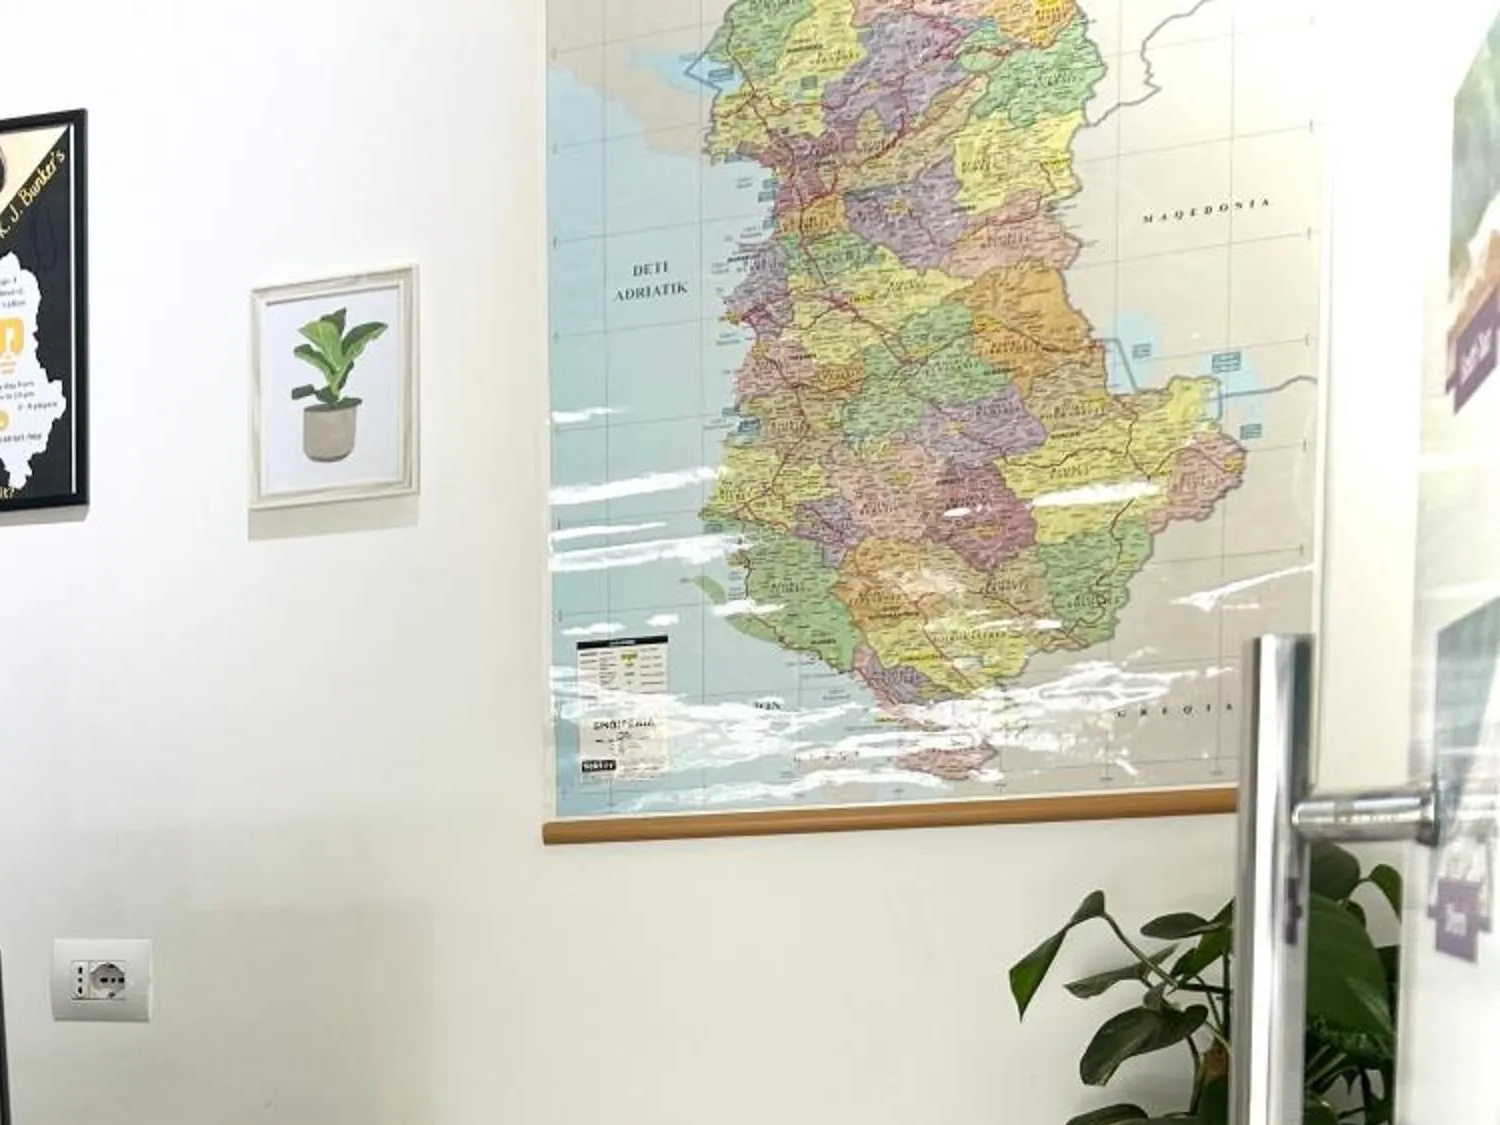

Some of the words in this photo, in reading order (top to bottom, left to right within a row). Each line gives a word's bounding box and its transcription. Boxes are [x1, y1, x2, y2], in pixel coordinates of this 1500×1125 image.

[18, 150, 65, 206] Bunker's
[633, 260, 668, 277] DETI
[615, 281, 688, 301] ADRIATIK
